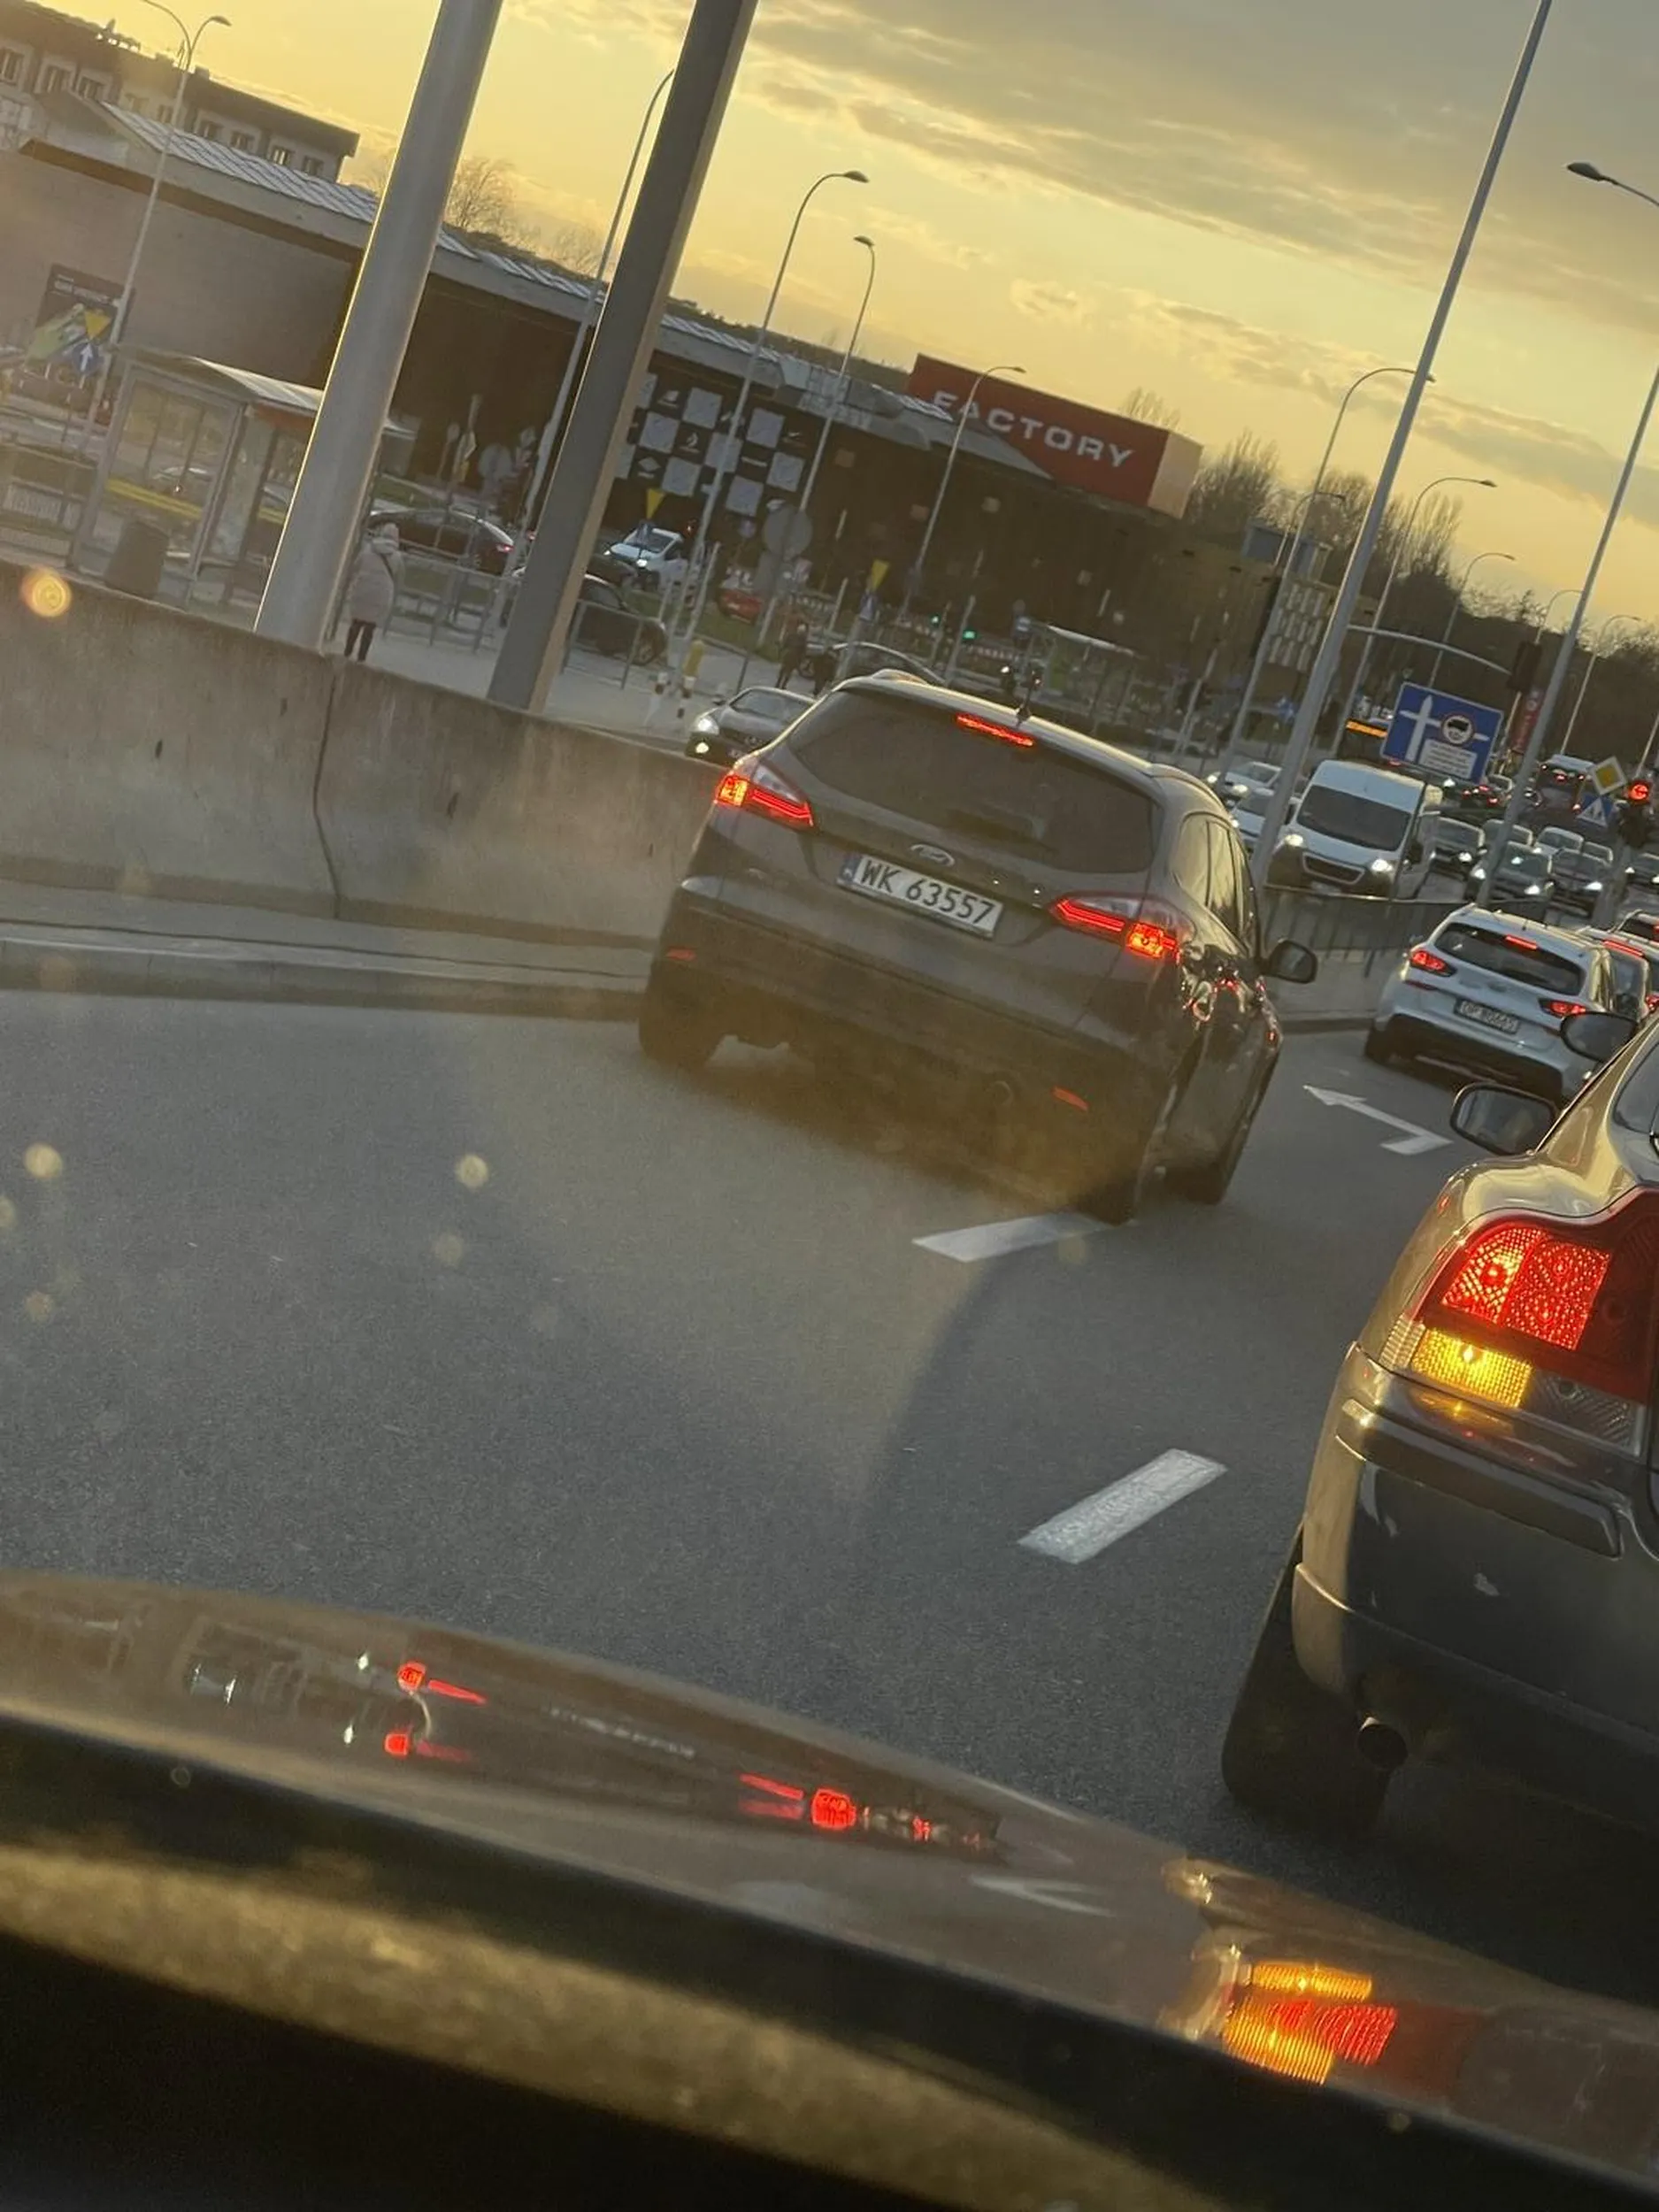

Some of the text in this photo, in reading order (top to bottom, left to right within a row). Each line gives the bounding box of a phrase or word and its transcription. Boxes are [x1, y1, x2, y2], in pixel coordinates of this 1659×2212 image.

[933, 390, 1134, 467] FACTORY
[859, 859, 996, 925] WK 63557
